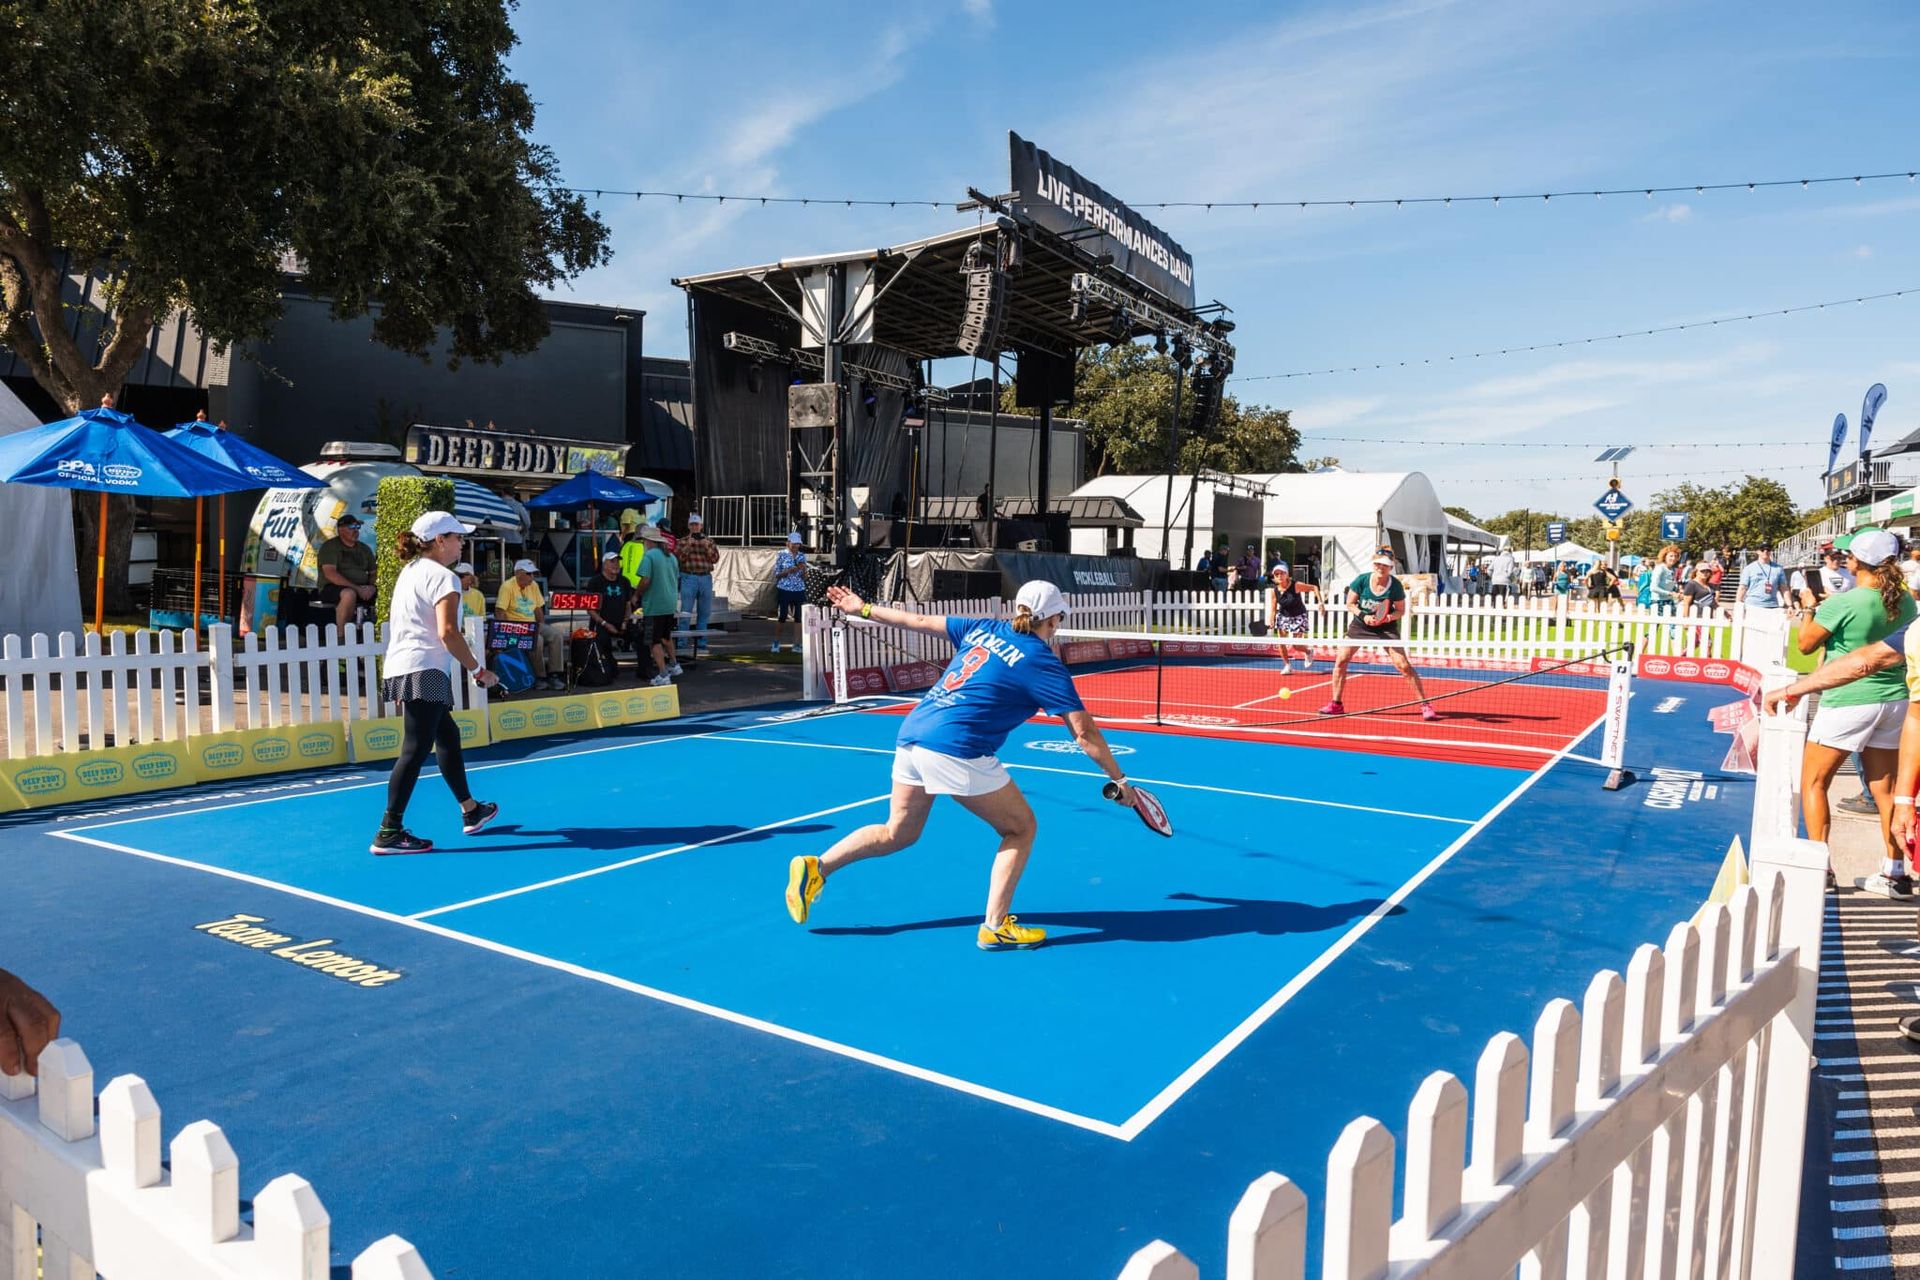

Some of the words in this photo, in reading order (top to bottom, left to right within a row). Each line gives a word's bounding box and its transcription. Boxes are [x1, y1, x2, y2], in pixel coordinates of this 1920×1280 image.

[1037, 169, 1072, 214] LIVE
[1072, 192, 1168, 271] PERFORMANCES
[1169, 252, 1192, 288] DAILY
[427, 434, 495, 469] DEEP
[501, 441, 566, 474] EDDY
[57, 471, 104, 484] OFFICIAL
[104, 478, 139, 486] VODKA
[271, 491, 302, 504] FOLLOW
[287, 506, 298, 514] TO
[259, 507, 300, 541] Fun
[1073, 570, 1117, 586] PICKLEBALL
[941, 645, 991, 693] 3
[1610, 692, 1625, 760] SWIFTNET
[82, 769, 100, 778] DEEP
[101, 767, 118, 777] EDDY
[138, 762, 155, 771] DEEP
[156, 760, 172, 769] EDDY
[23, 776, 40, 786] DEEP
[42, 774, 60, 784] EDDY
[194, 913, 292, 948] Team
[270, 938, 402, 988] Lemon
